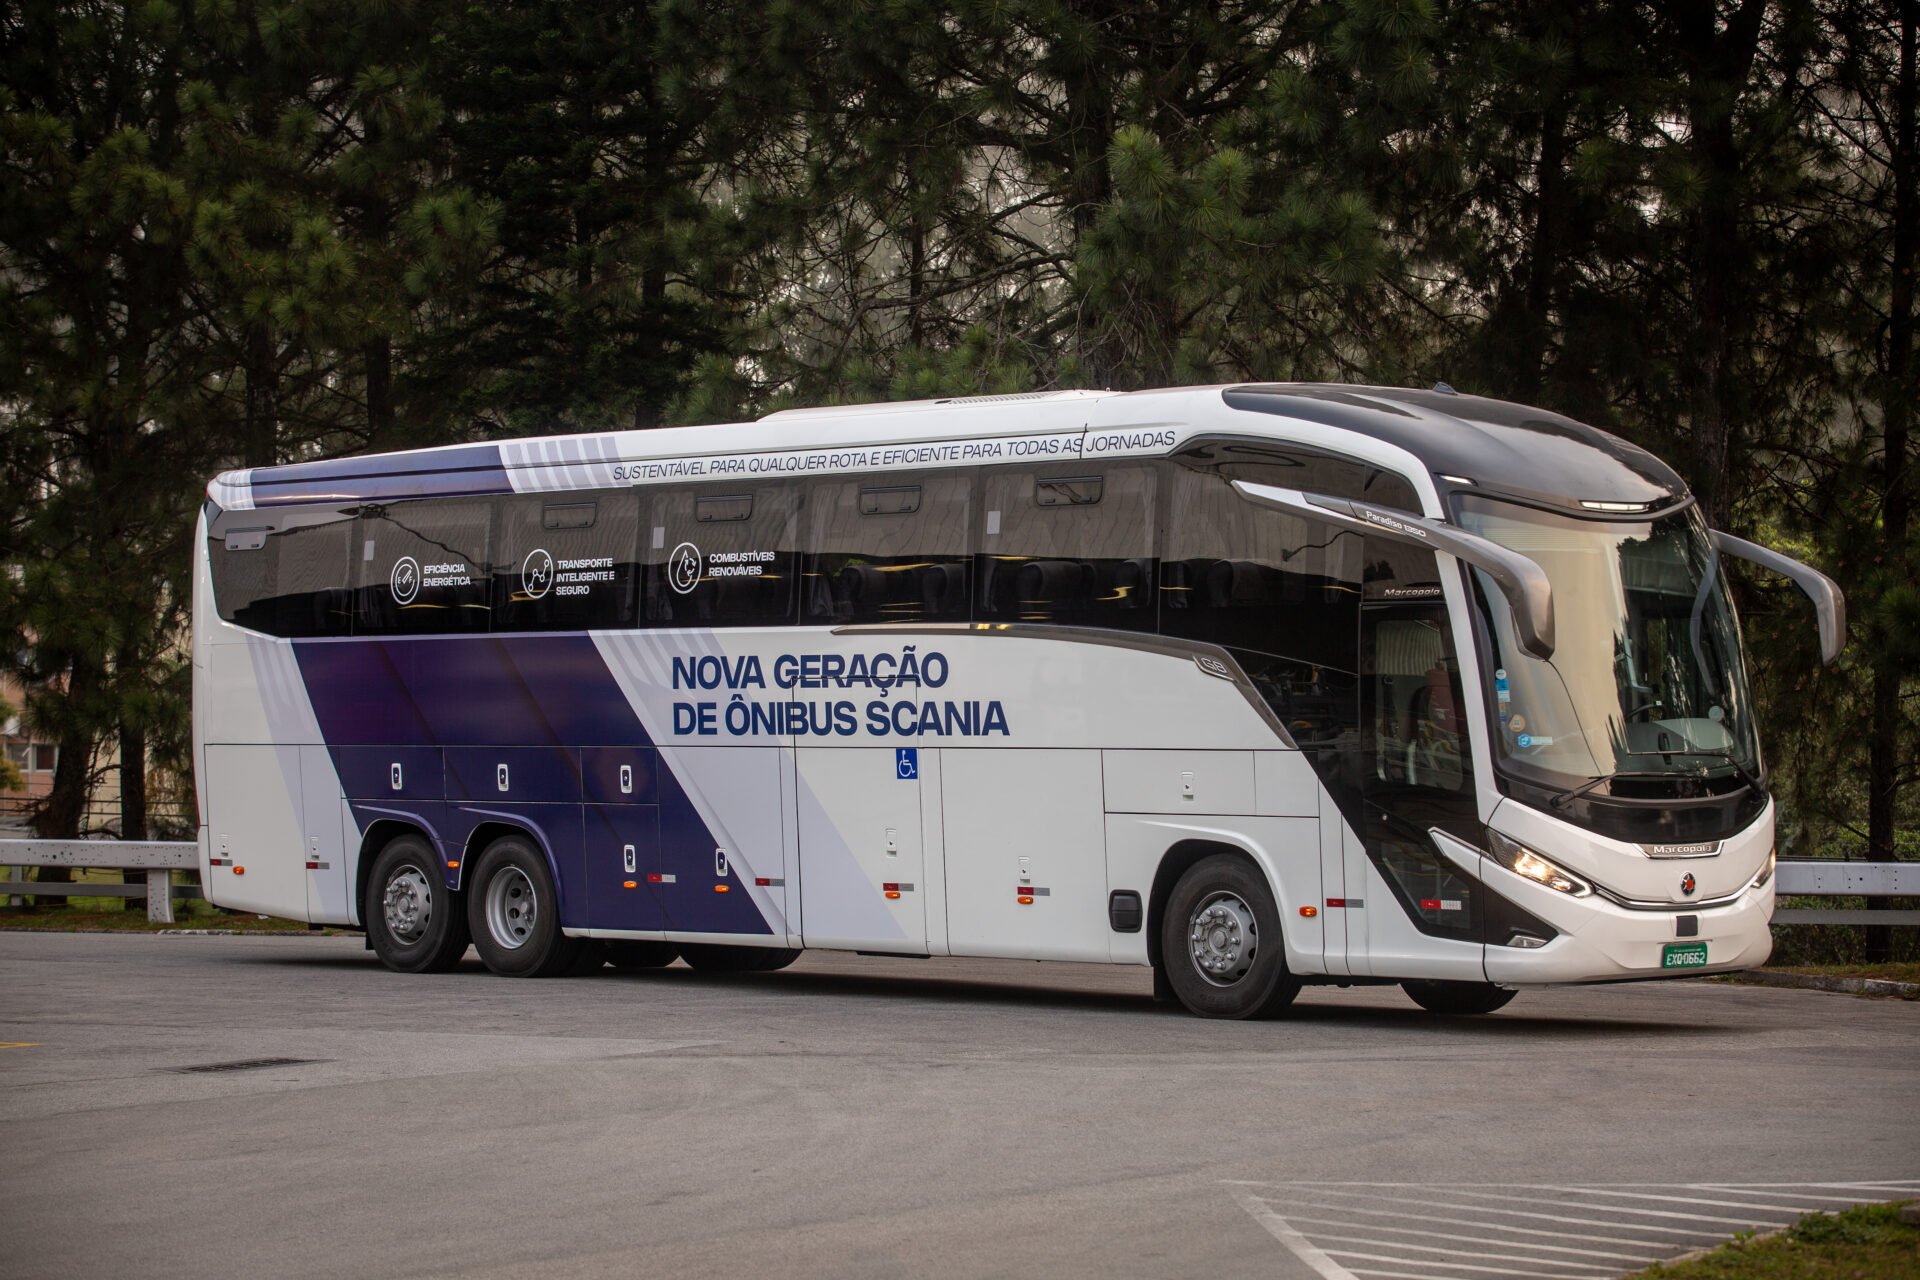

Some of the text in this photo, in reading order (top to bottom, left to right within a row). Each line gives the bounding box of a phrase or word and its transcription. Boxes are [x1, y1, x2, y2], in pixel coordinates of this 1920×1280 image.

[613, 430, 1176, 480] SUSTENTÁVEL PARA QUALQUER ROTA E EFICIENTE PARA TODAS AS JORNADAS
[1366, 511, 1402, 528] Paradiso
[709, 550, 776, 563] COMBUSTÍVEIS
[424, 563, 465, 574] EFICIÊNCIA
[557, 558, 613, 569] TRANSPORTE
[708, 564, 763, 577] RENOVÁVEIS
[423, 576, 471, 587] ENERGÉTICA
[556, 571, 615, 582] INTELIGENTE E
[555, 585, 590, 596] SEGURO
[1384, 588, 1440, 597] Marcopolo
[672, 645, 949, 698] NOVA GERAÇÃO
[673, 693, 1011, 737] DE ÔNIBUS SCANIA
[1653, 844, 1712, 854] Marcopolo
